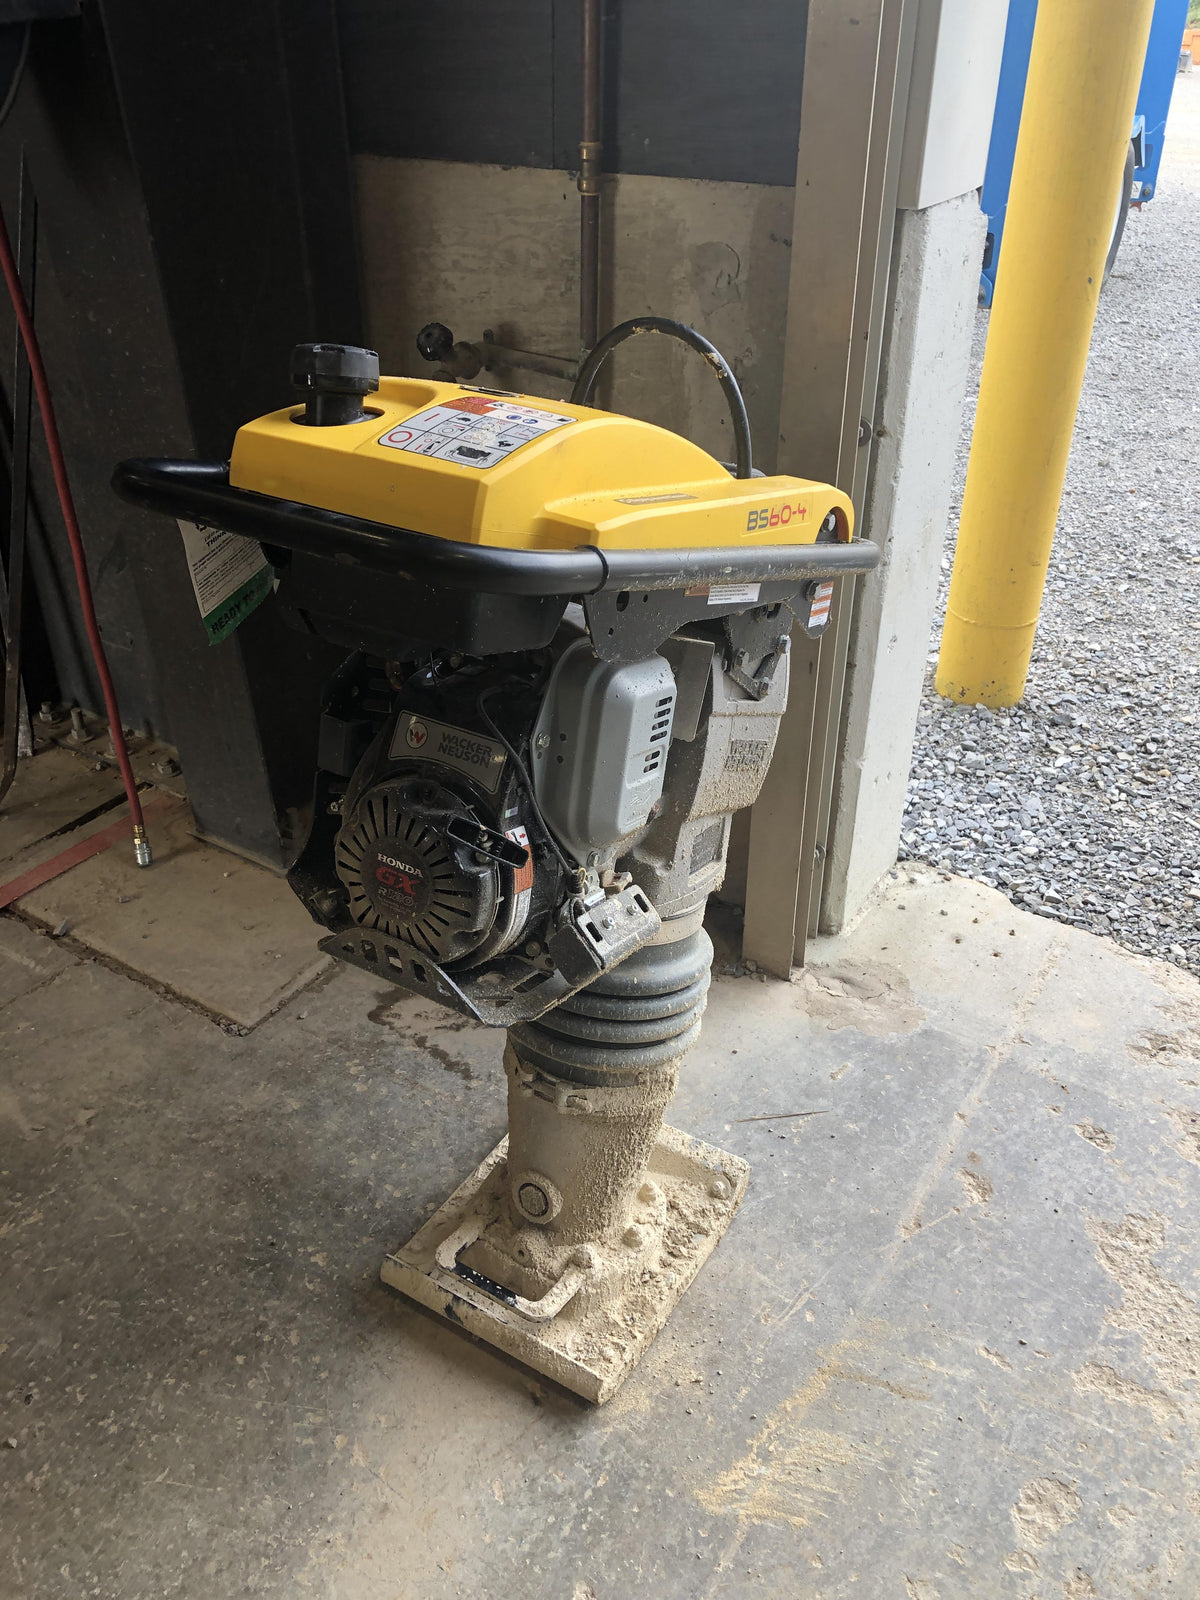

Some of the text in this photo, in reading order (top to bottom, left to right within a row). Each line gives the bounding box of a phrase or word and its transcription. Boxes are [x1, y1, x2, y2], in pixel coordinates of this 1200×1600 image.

[746, 503, 807, 532] BS60-4
[438, 742, 490, 768] NEUSON
[442, 732, 493, 757] WACKER
[376, 852, 424, 878] HONDA
[375, 866, 421, 896] GX
